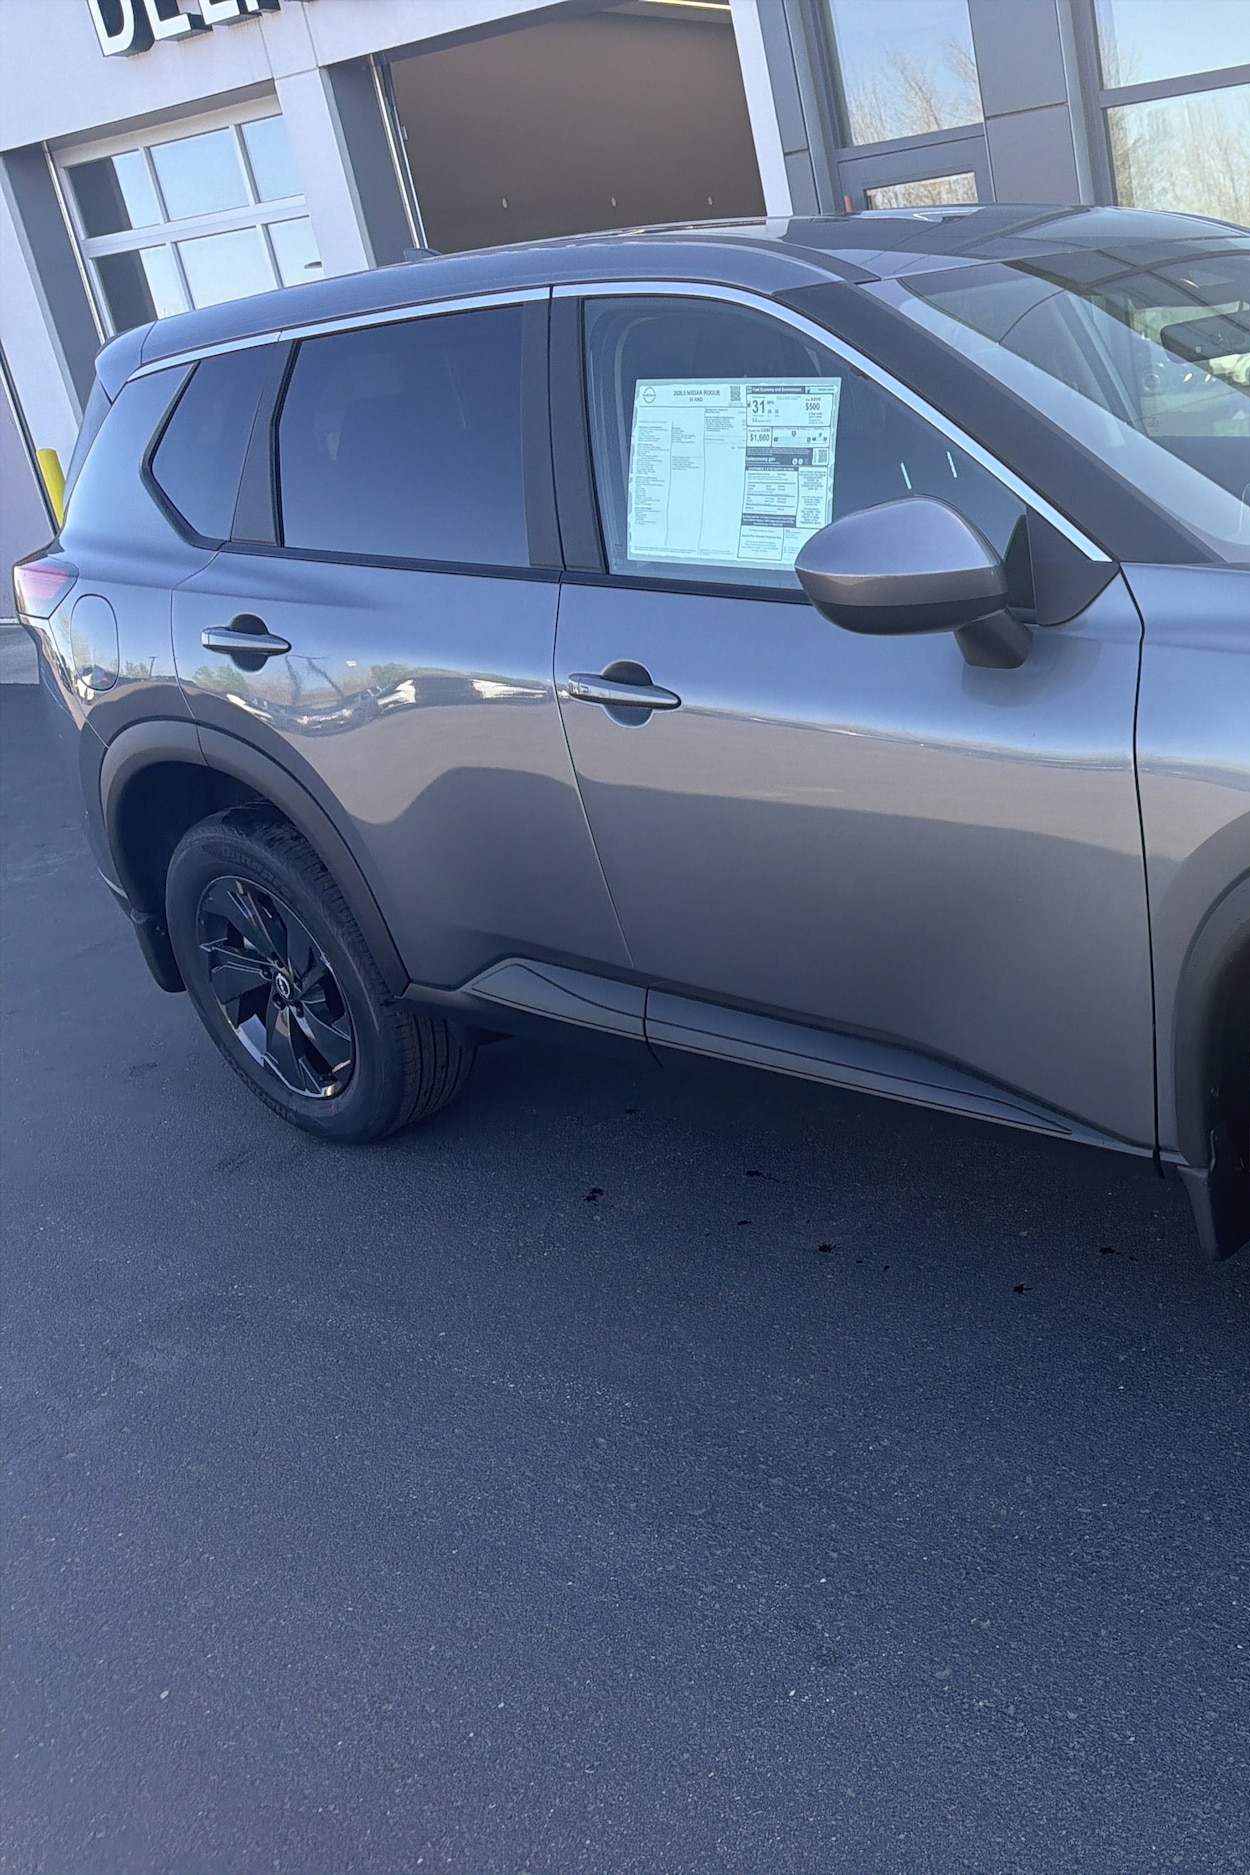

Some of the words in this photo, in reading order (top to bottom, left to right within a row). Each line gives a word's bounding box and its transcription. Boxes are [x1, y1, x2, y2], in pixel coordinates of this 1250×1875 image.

[752, 400, 765, 414] 31
[805, 402, 820, 411] $500
[750, 434, 770, 443] $1,600
